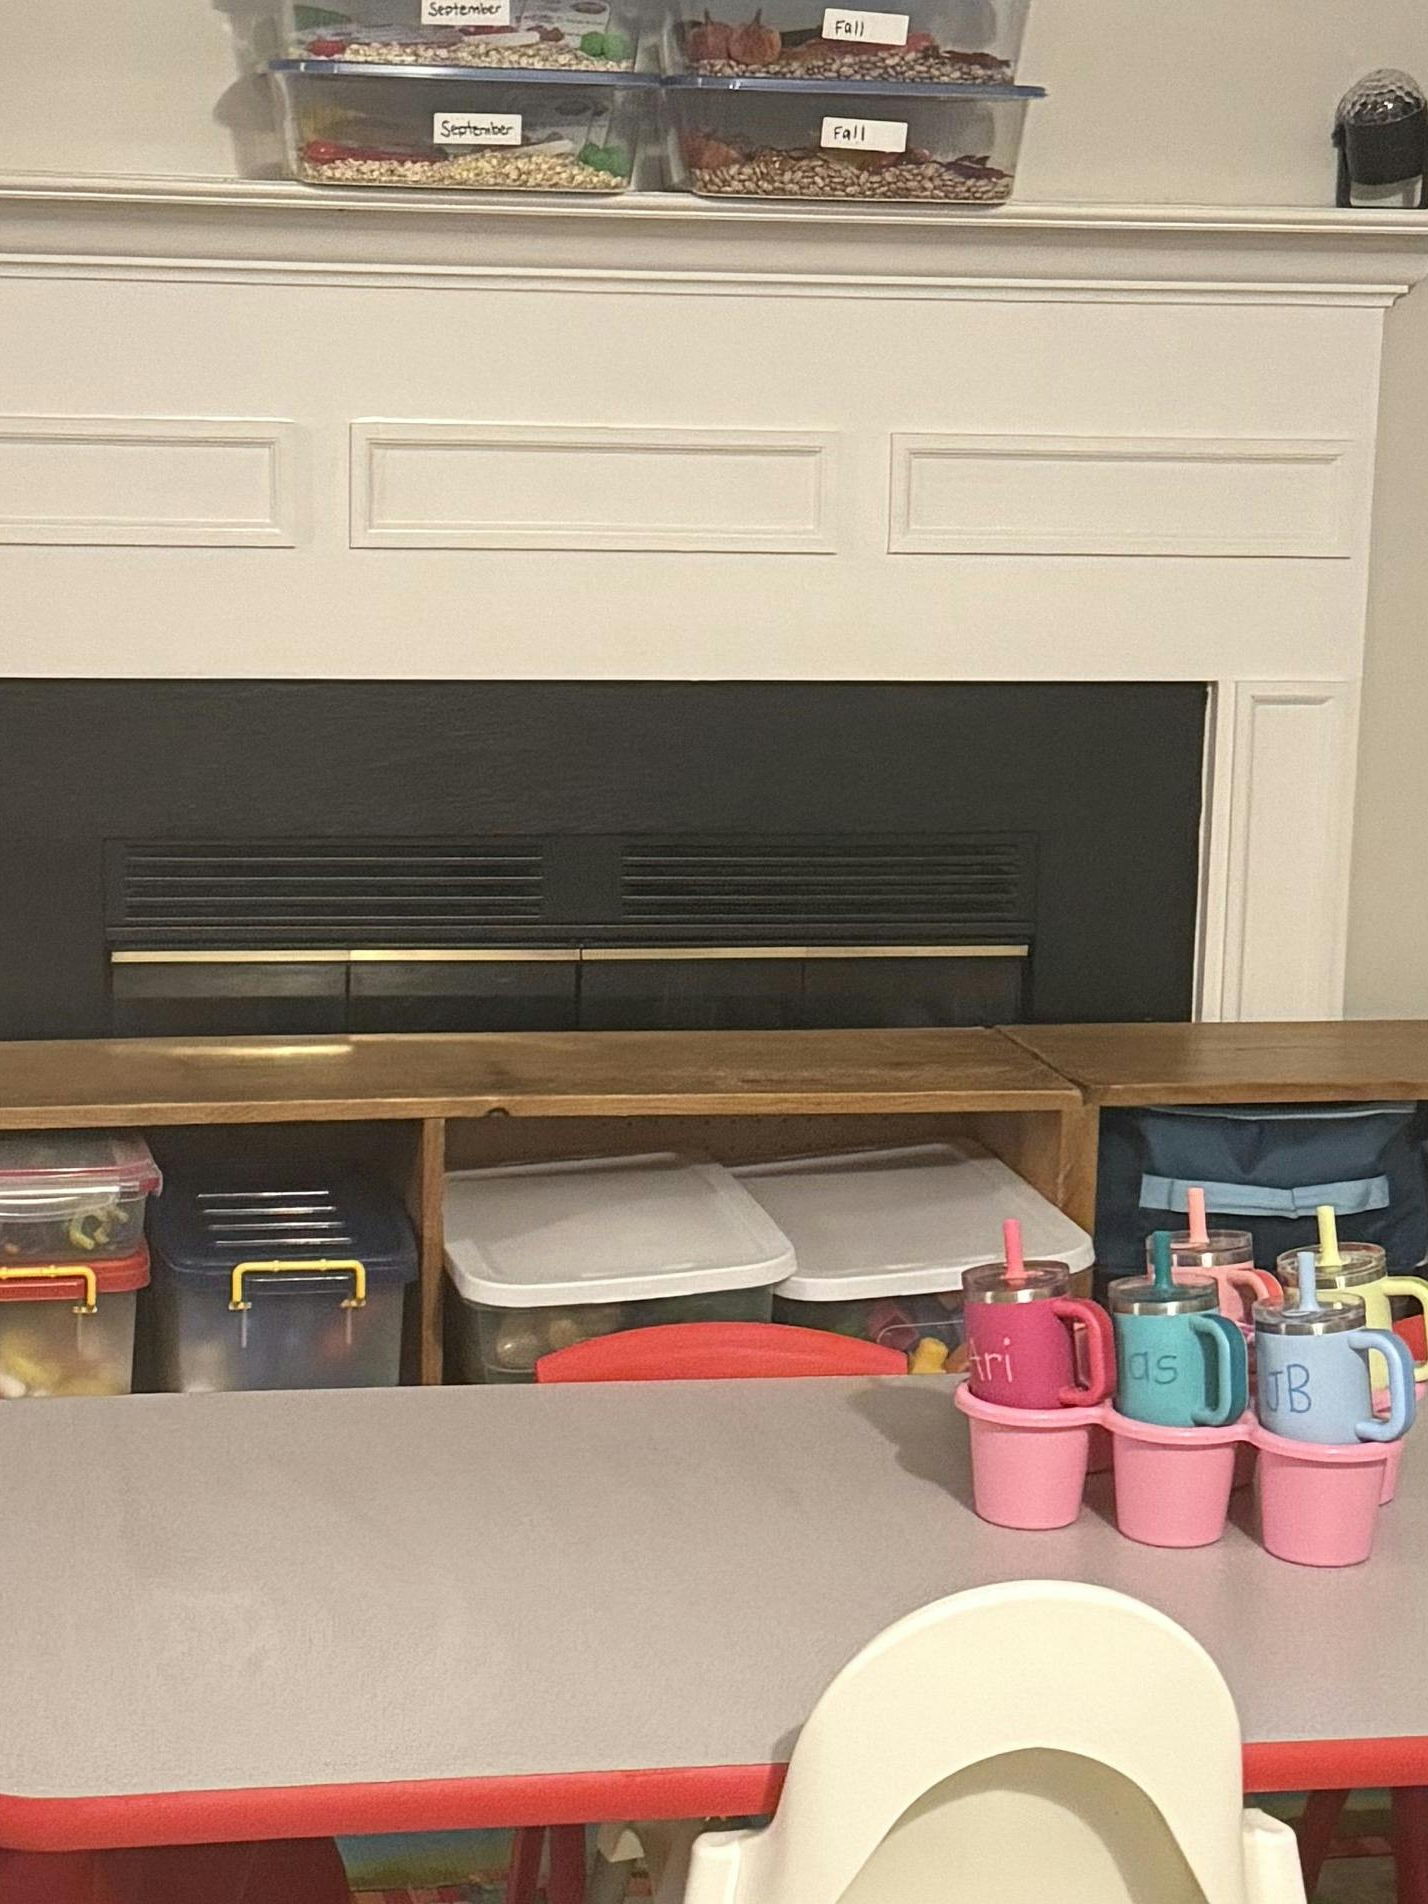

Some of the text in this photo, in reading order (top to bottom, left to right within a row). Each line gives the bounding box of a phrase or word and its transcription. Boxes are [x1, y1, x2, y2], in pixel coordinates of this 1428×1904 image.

[427, 1, 502, 17] September
[834, 19, 865, 37] Fall
[440, 119, 514, 138] September
[833, 124, 866, 142] Fall
[1266, 1363, 1312, 1414] JB
